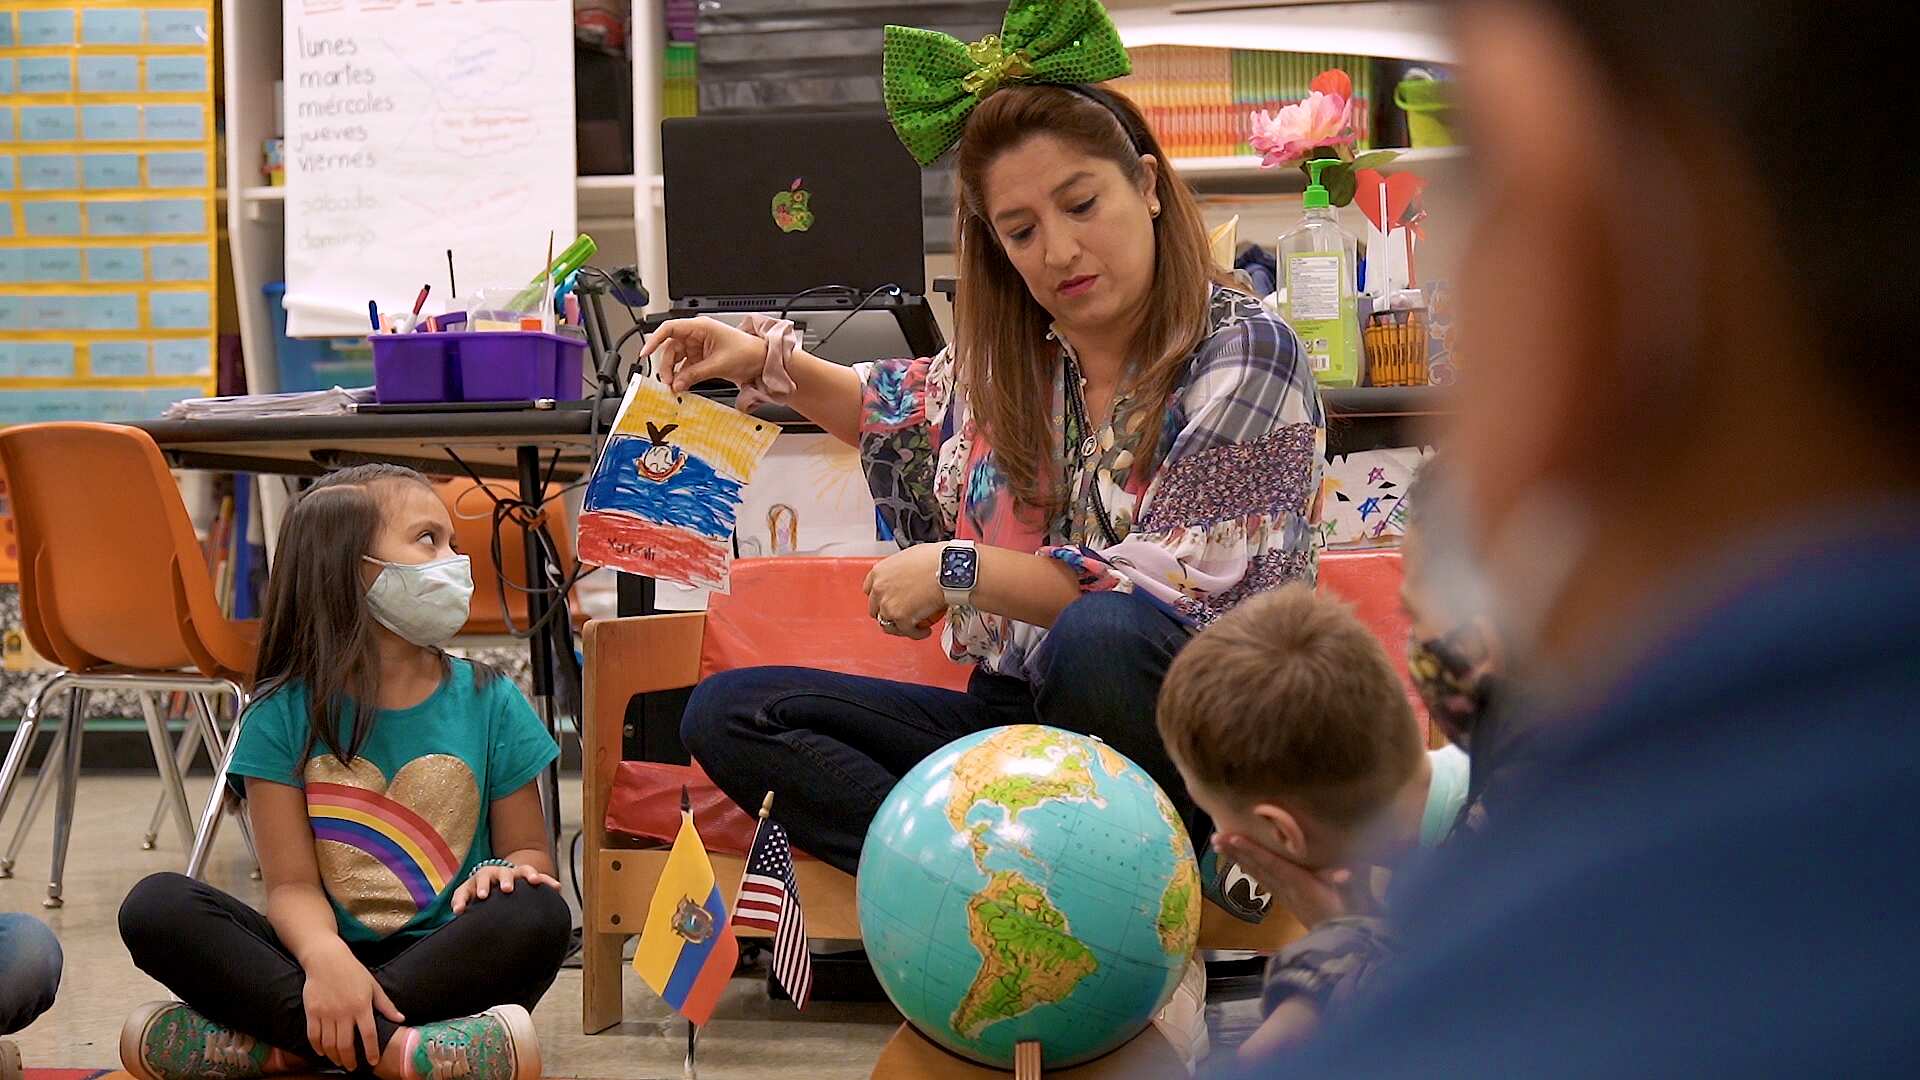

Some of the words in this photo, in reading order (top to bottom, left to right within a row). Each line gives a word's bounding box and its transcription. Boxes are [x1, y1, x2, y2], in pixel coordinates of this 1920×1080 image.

[297, 25, 358, 59] lunes
[299, 63, 375, 88] martes
[296, 123, 368, 151] jueves
[299, 152, 376, 173] viernes
